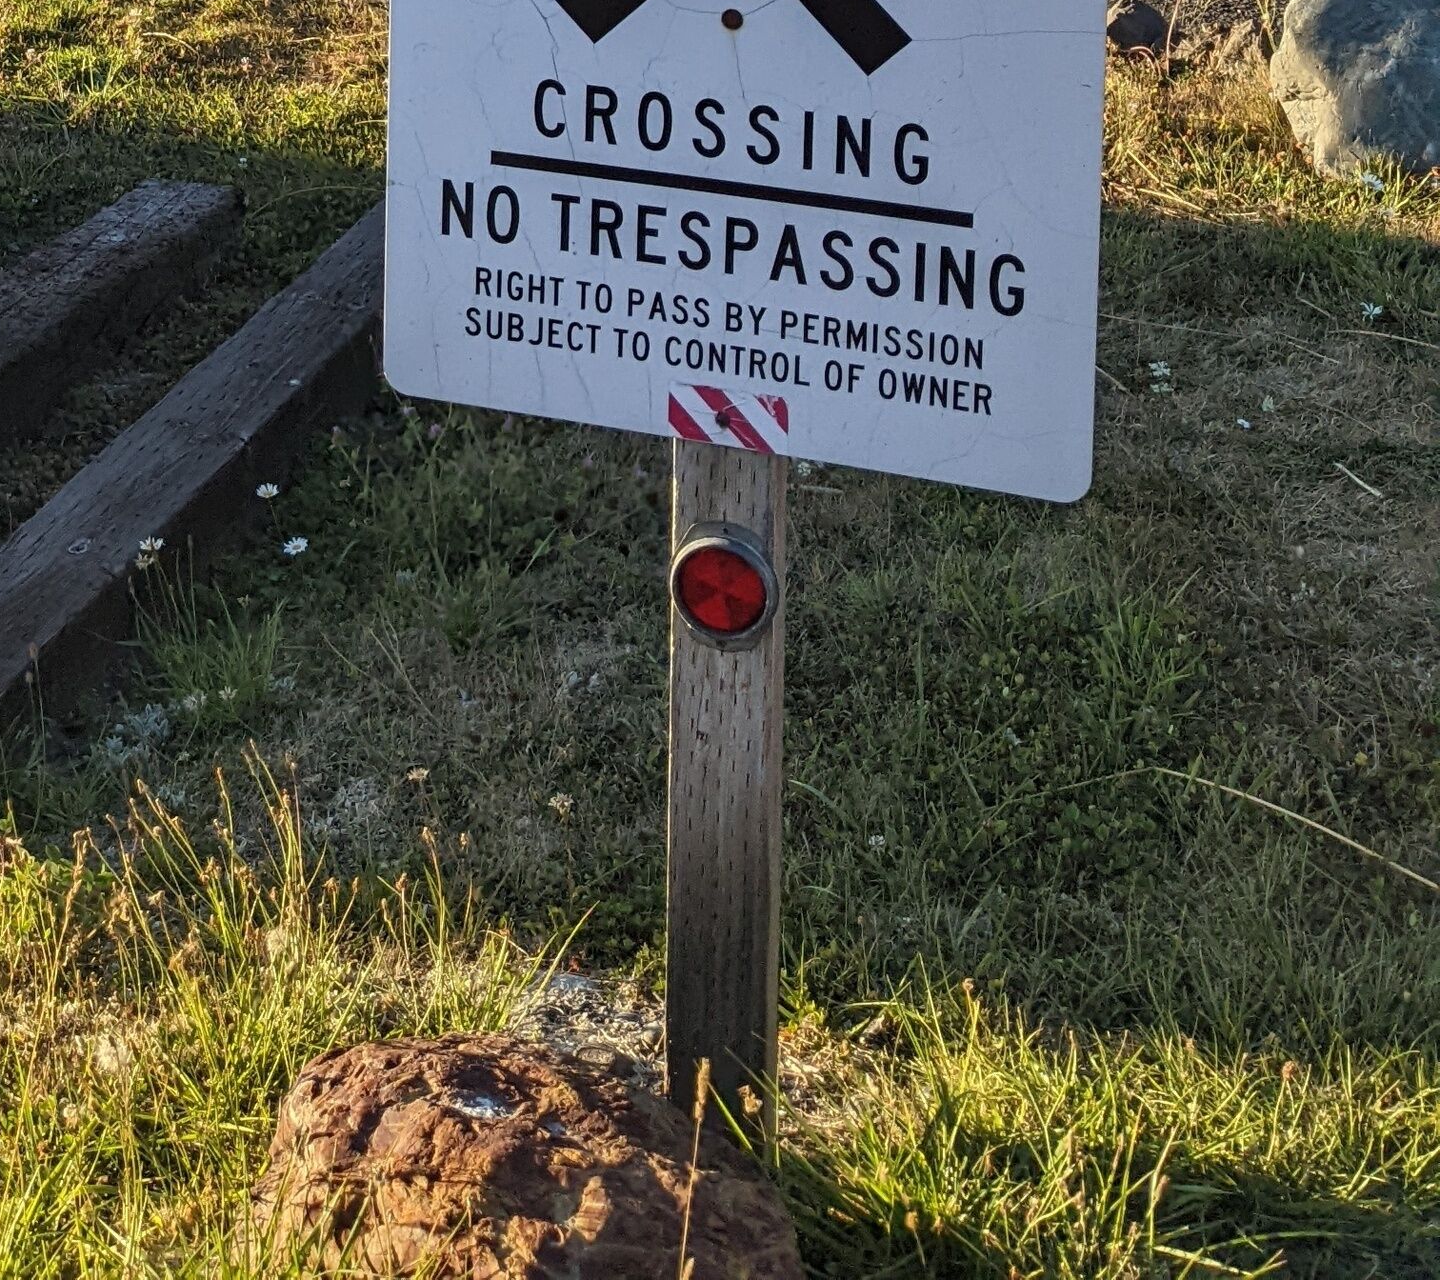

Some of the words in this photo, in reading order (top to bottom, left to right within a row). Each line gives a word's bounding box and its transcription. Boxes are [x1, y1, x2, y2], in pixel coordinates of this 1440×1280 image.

[534, 79, 930, 185] CROSSING
[442, 179, 520, 244] NO
[551, 193, 1026, 316] TRESPASSING
[465, 307, 601, 354] SUBJECT
[613, 328, 650, 361] TO
[665, 336, 811, 386] CONTROL
[825, 360, 865, 394] OF
[879, 369, 993, 415] OWNER
[475, 267, 564, 306] RIGHT
[576, 281, 613, 314] TO
[628, 288, 710, 327] PASS
[726, 302, 767, 335] BY
[781, 310, 984, 370] PERMISSION
